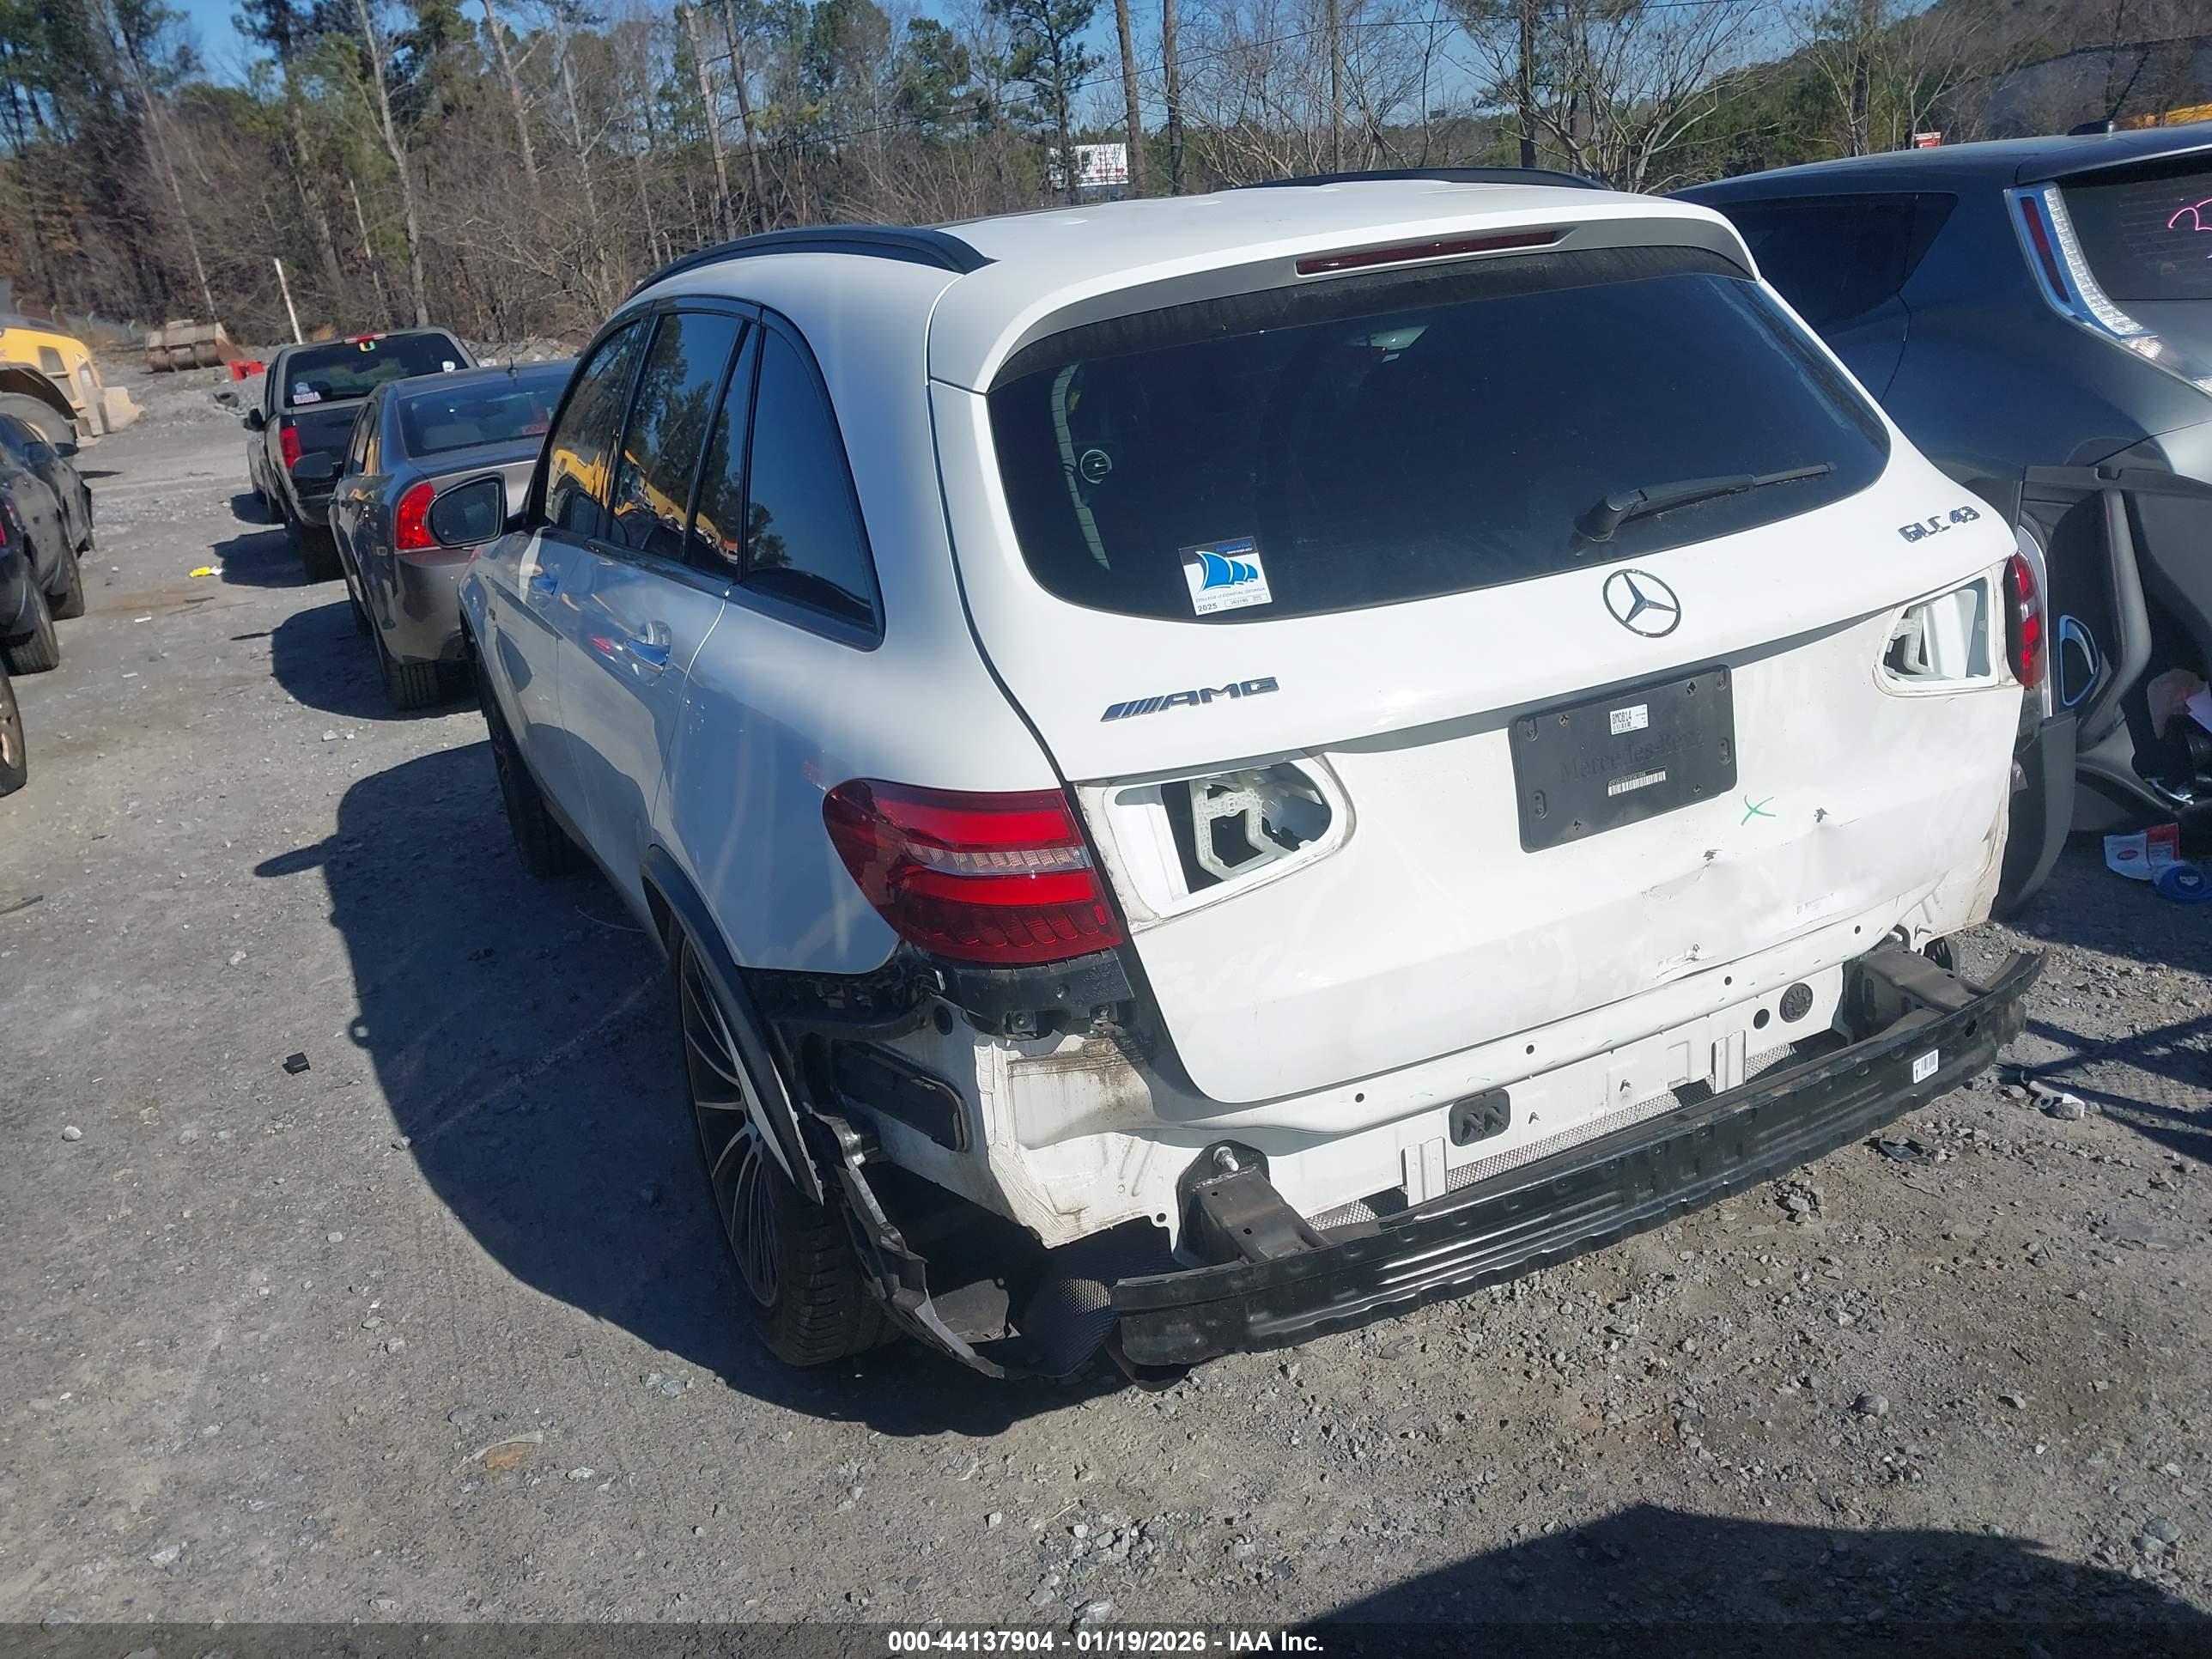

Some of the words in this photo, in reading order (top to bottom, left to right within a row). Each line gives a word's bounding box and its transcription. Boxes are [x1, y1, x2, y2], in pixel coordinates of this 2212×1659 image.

[1898, 515, 1951, 543] GLC
[1949, 506, 1980, 524] 43
[1197, 602, 1218, 612] 2025
[1156, 676, 1279, 712] AMG
